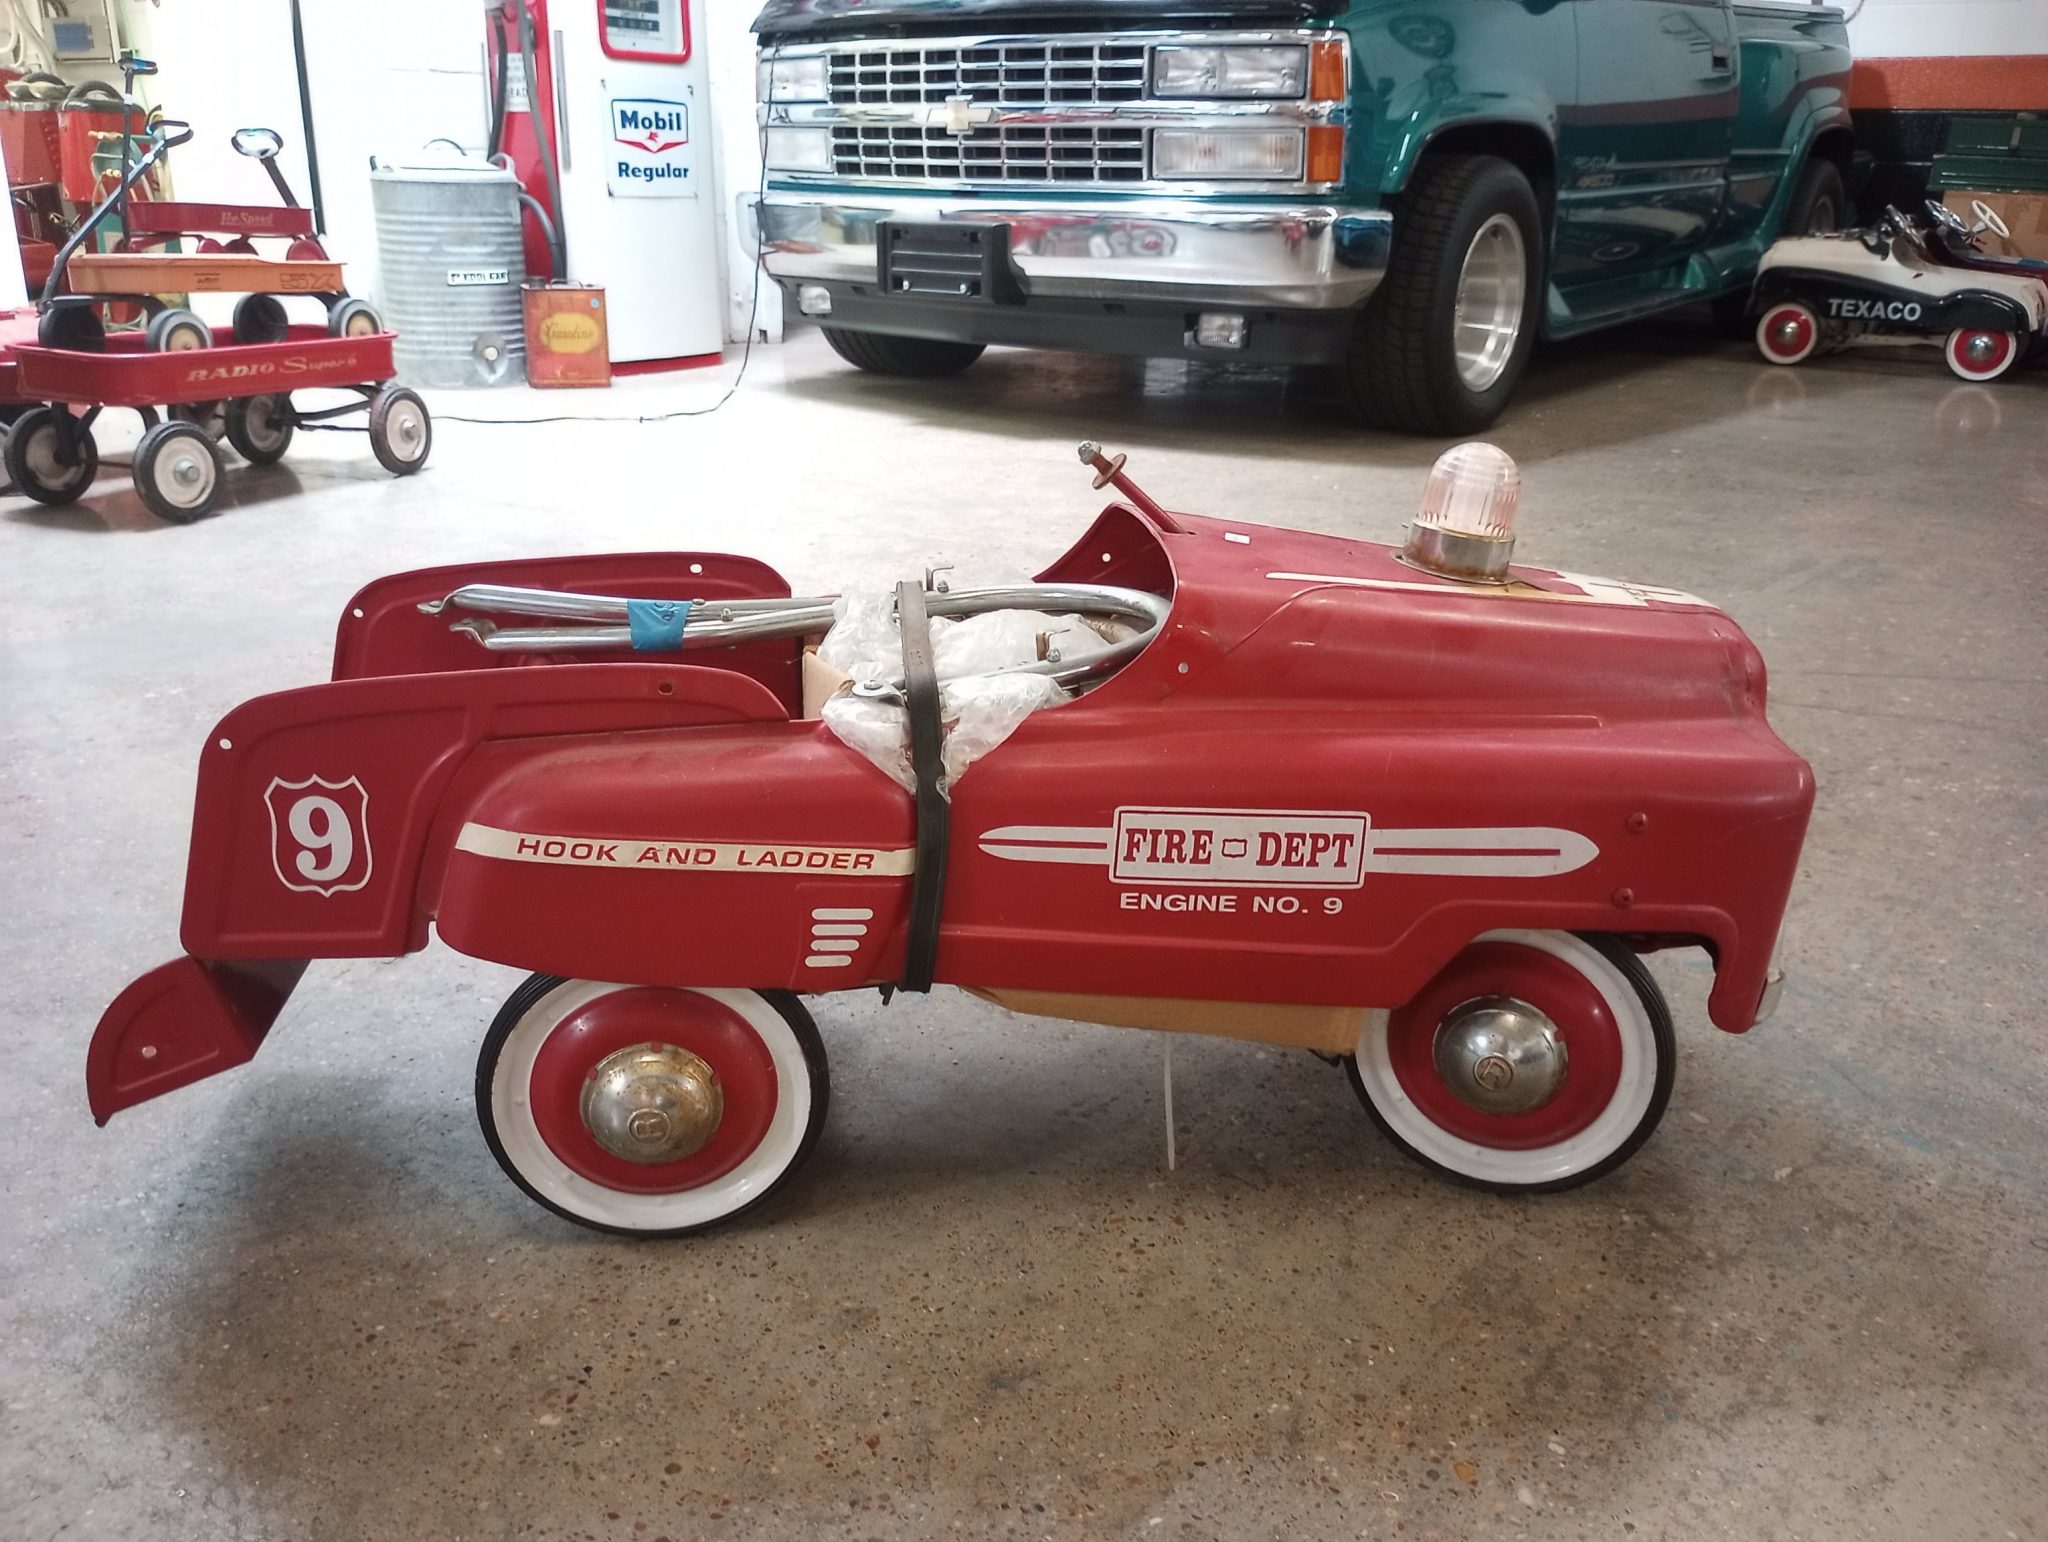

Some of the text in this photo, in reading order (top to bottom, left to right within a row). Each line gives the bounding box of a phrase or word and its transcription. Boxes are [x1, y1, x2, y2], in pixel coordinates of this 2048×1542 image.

[620, 109, 682, 131] Mobil
[618, 161, 689, 182] Regular
[1827, 298, 1922, 321] TEXACO
[186, 361, 275, 382] RADIO
[288, 795, 353, 881] 9
[1123, 828, 1355, 868] FIRE DEPT
[517, 838, 875, 870] HOOK AND LADDER
[1120, 892, 1344, 914] ENGINE NO. 9
